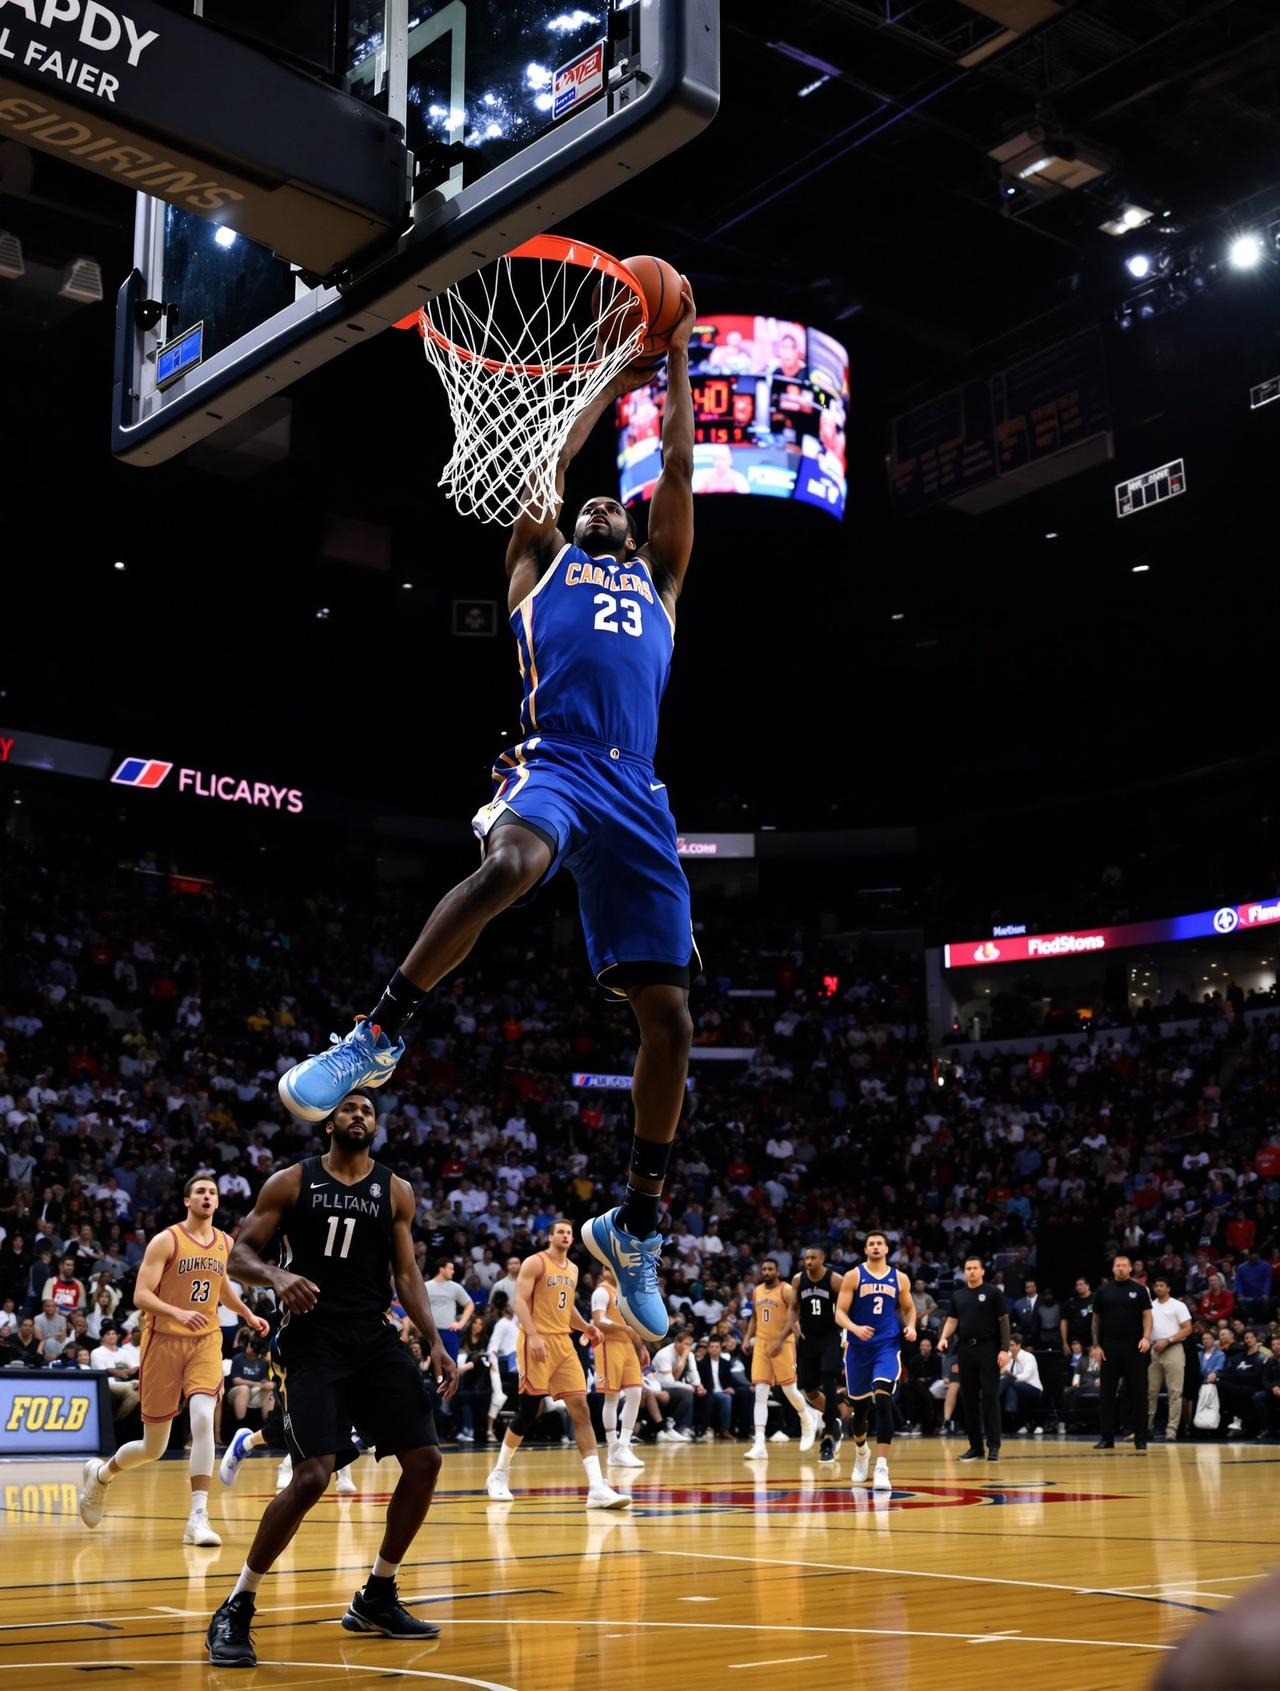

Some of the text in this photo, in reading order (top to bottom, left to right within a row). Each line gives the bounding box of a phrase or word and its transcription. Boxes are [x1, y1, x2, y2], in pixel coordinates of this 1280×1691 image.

[24, 41, 119, 102] FAIER
[593, 592, 643, 637] 23
[179, 768, 303, 813] FLICARYS
[324, 1215, 356, 1258] 11
[190, 1280, 211, 1303] 23
[556, 1290, 567, 1310] 3
[5, 1395, 90, 1431] FOLB
